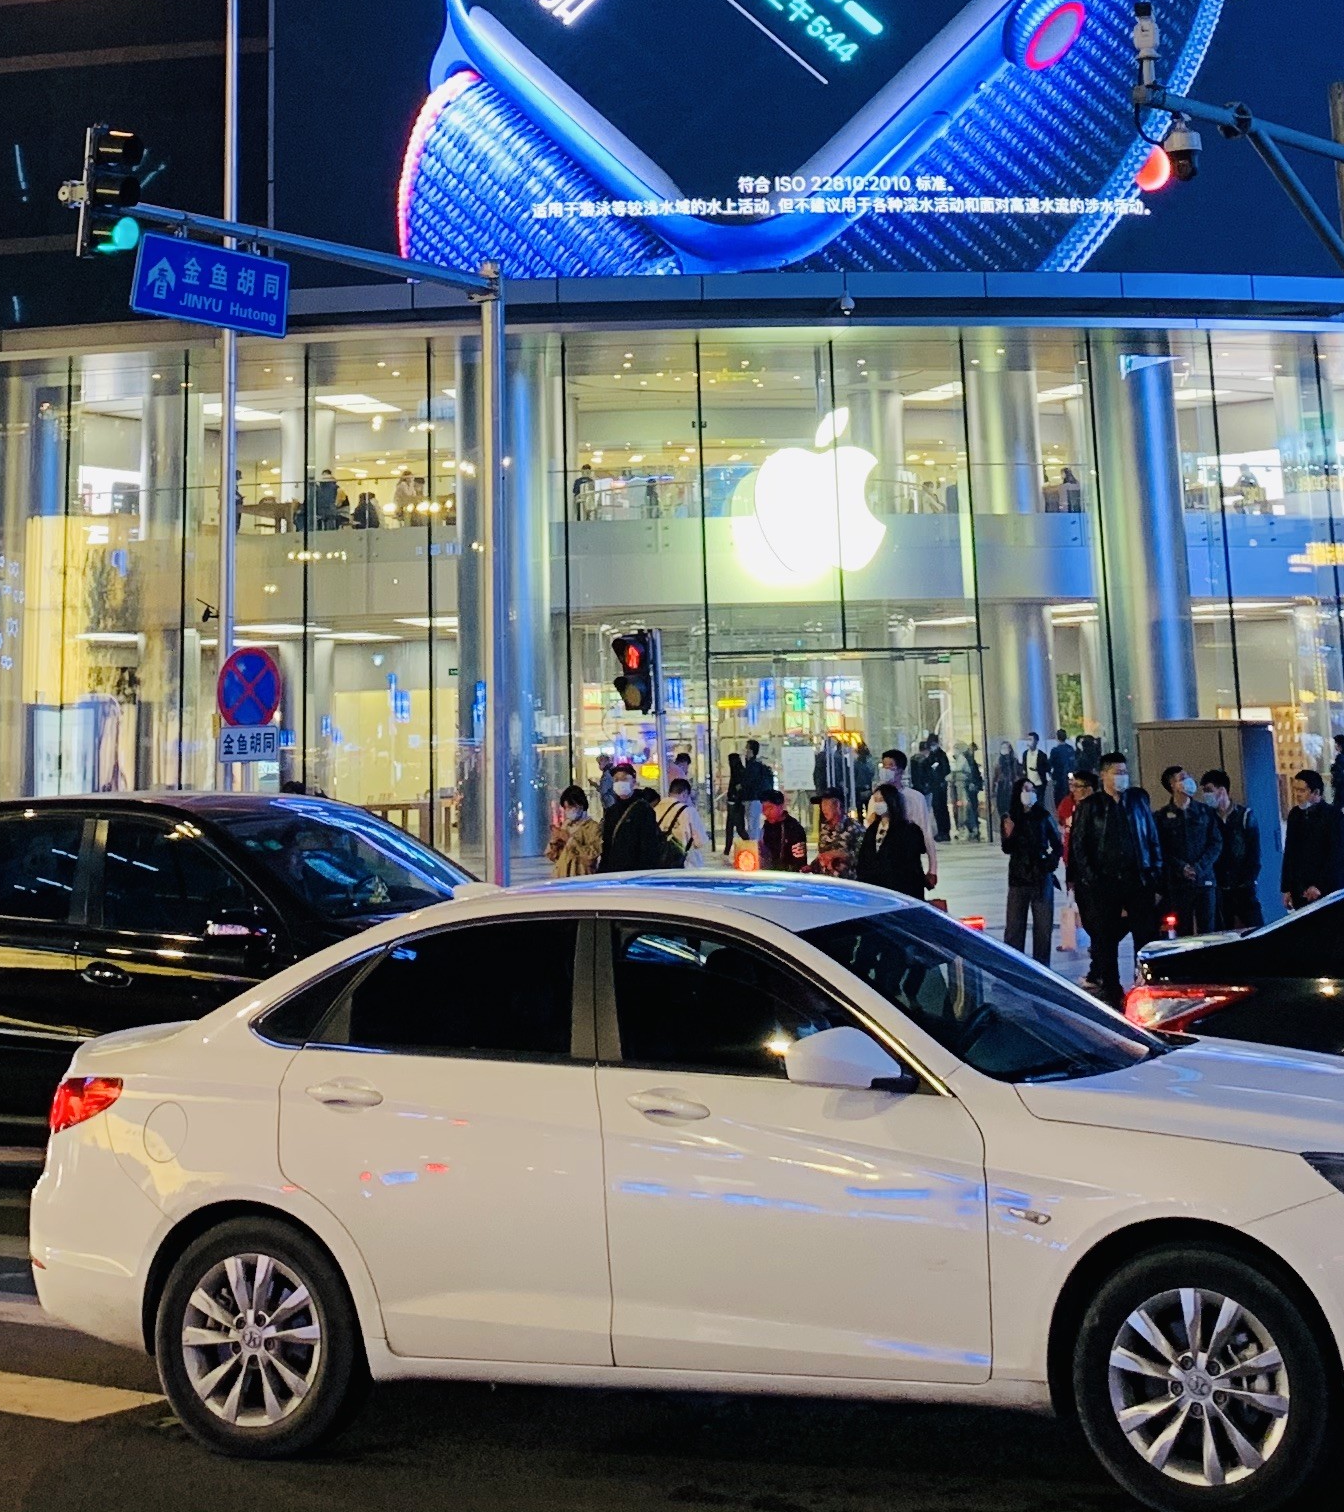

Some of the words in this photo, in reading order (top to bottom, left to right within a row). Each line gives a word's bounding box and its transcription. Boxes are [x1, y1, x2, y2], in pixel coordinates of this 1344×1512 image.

[737, 175, 771, 194] 符合
[774, 176, 805, 193] ISO
[810, 175, 911, 192] 22810:2010
[181, 257, 280, 301] 金鱼胡同
[179, 292, 223, 313] JINYU
[229, 302, 277, 327] Hutong
[223, 732, 275, 755] 金鱼胡同
